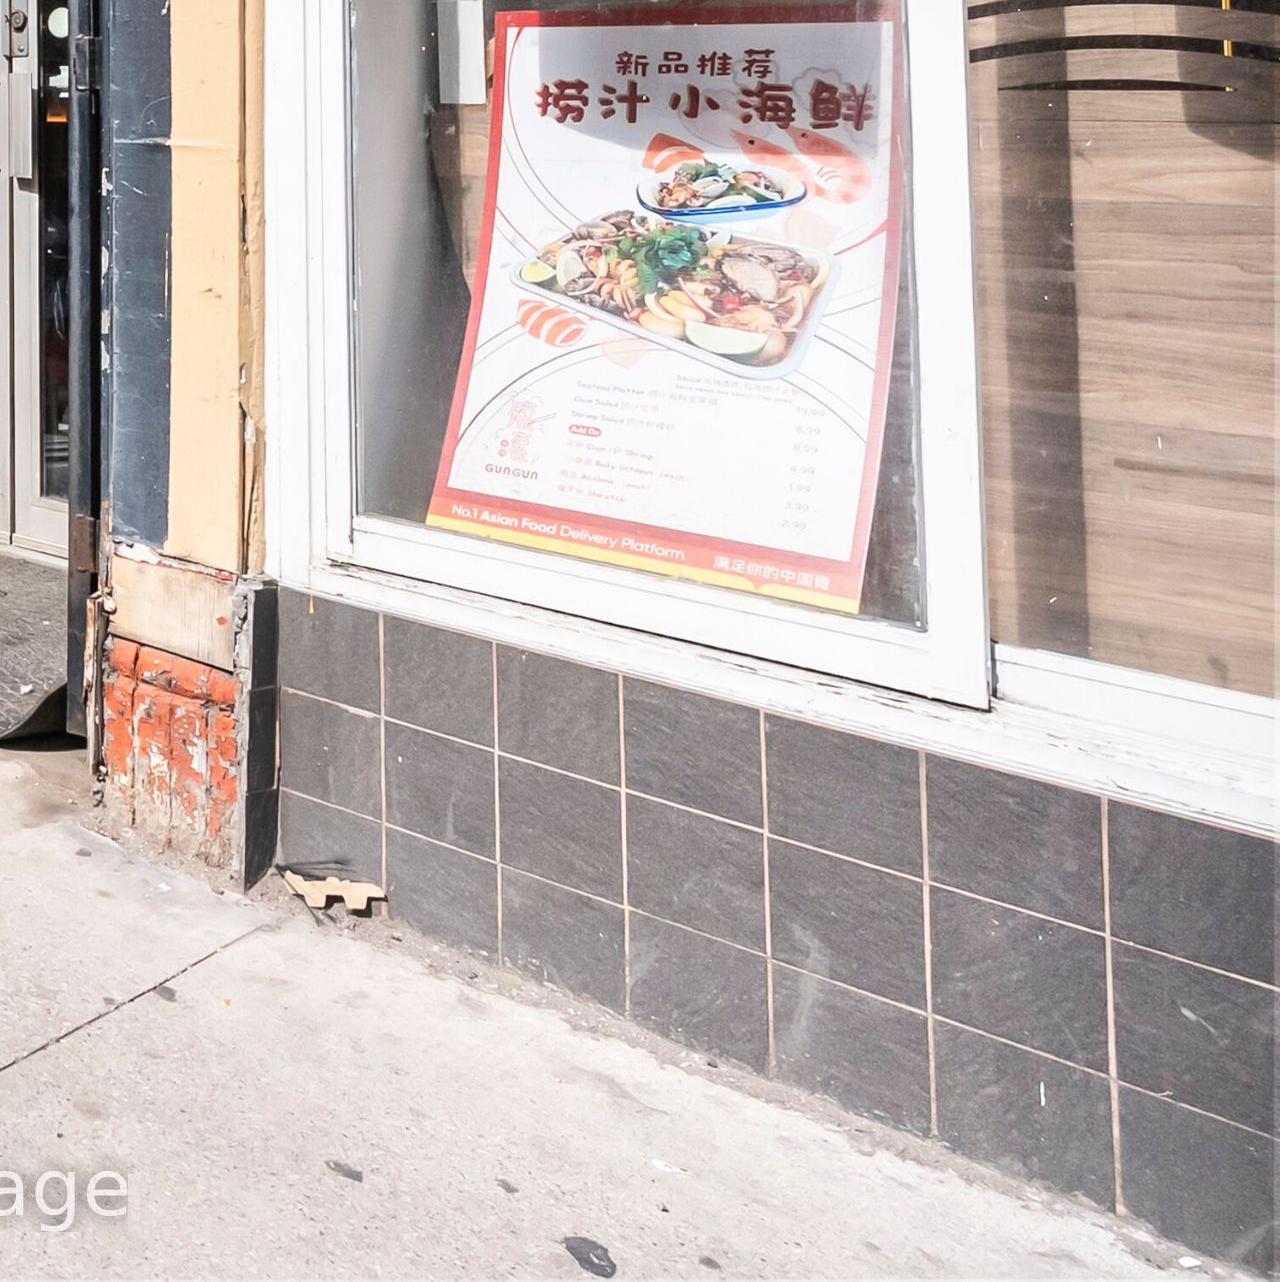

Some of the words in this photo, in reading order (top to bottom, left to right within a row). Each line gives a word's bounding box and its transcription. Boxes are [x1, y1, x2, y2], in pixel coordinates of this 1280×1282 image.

[615, 48, 775, 79] 新品推荐
[536, 79, 876, 131] 捞汁小海鲜
[452, 504, 479, 521] No.1
[480, 510, 518, 527] Asian
[521, 517, 557, 535] Food
[559, 525, 619, 549] Delivery
[621, 536, 687, 561] Platform
